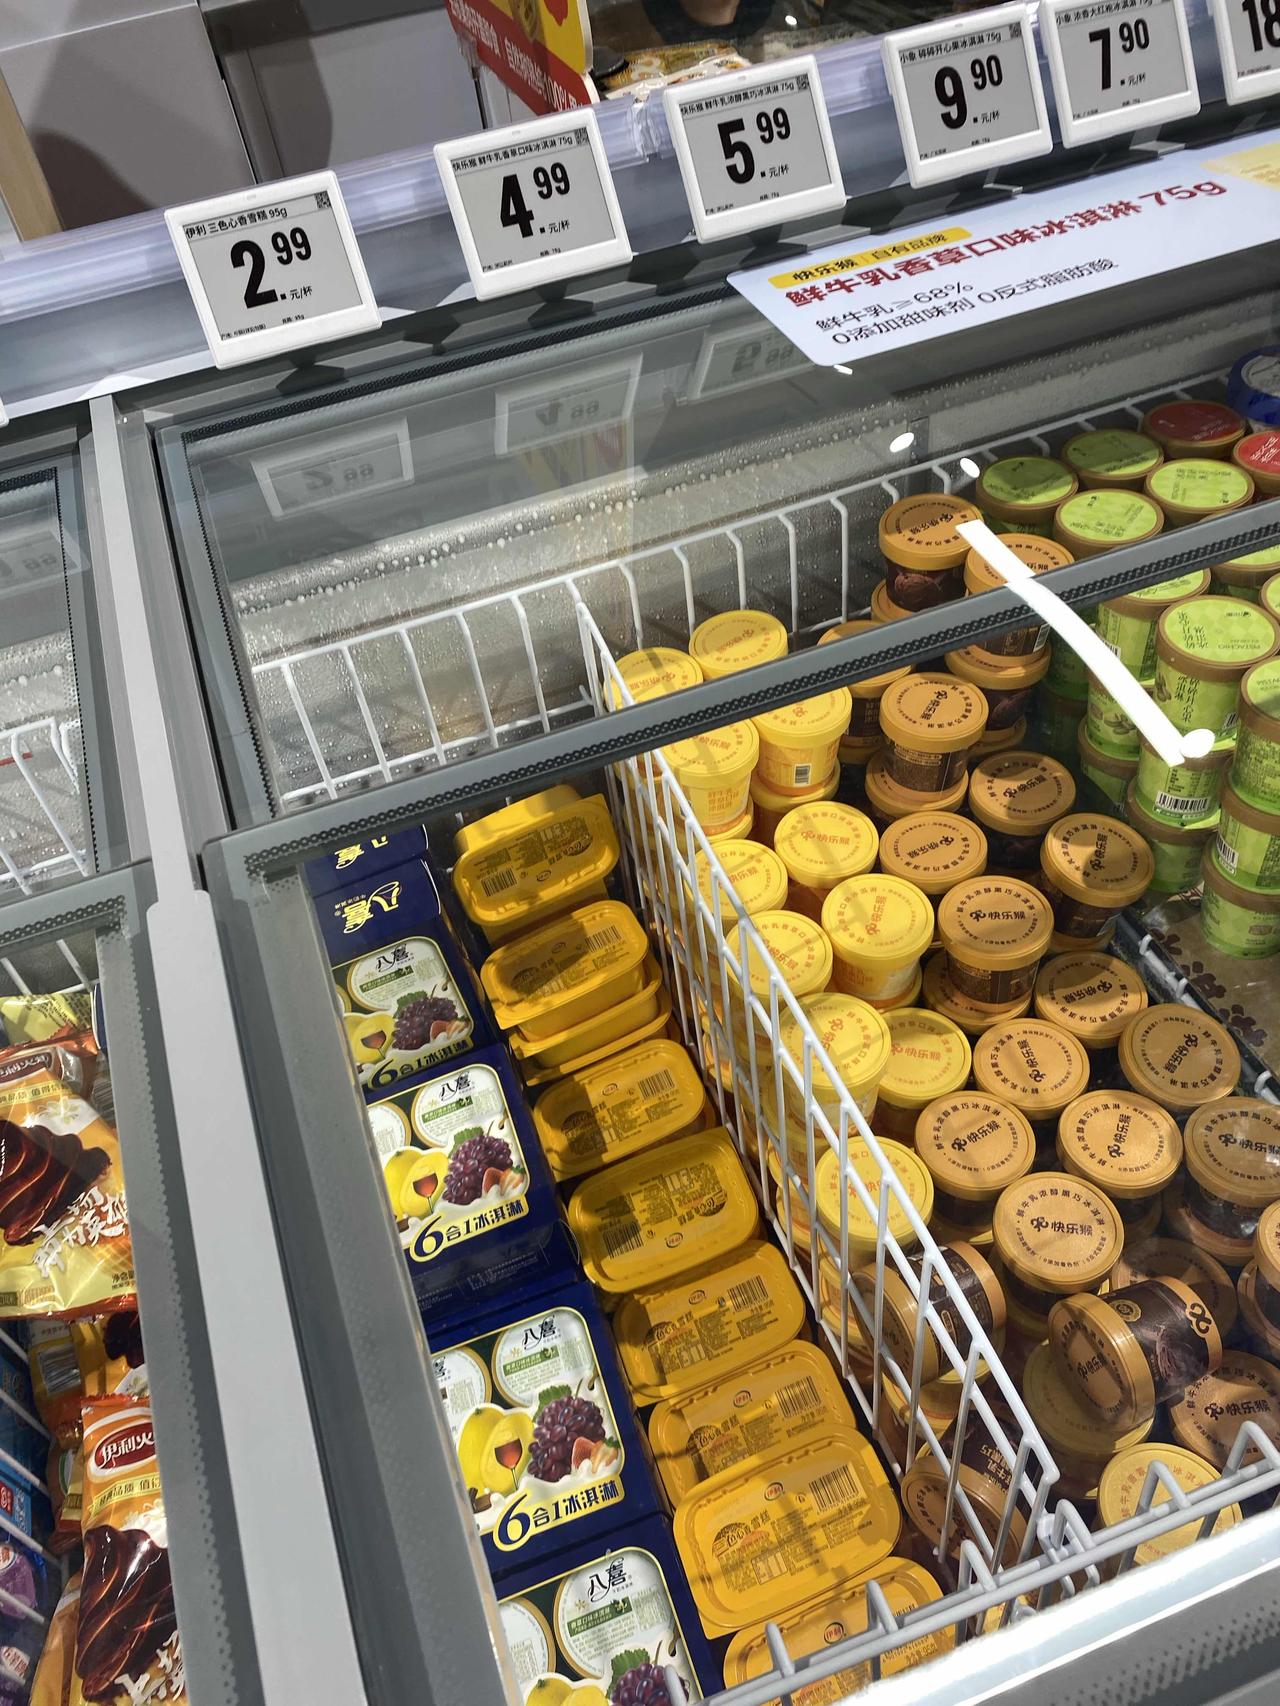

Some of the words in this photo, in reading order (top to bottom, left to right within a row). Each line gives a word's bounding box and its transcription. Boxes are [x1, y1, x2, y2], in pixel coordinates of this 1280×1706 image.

[185, 226, 206, 239] 伊利
[269, 206, 288, 218] 95g
[785, 200, 1142, 308] 鲜牛乳香草口味冰淇淋
[1139, 181, 1228, 206] 75g
[792, 259, 858, 281] 快乐猴
[872, 234, 948, 260] 自有品牌
[832, 298, 976, 346] 0添加甜味剂
[976, 258, 1119, 304] 0反式脂肪酸
[920, 699, 941, 721] 快乐猴
[1017, 775, 1047, 792] 快乐猴
[816, 834, 850, 846] 快乐猴
[907, 841, 939, 860] 快乐猴
[871, 895, 887, 926] 快乐猴
[988, 911, 1027, 922] 快乐猴
[1063, 986, 1097, 1005] 快乐猴
[905, 1048, 941, 1062] 快乐猴
[1017, 1038, 1040, 1069] 快乐猴
[1163, 1041, 1190, 1075] 快乐猴
[966, 1120, 1002, 1144] 快乐猴
[1112, 1113, 1132, 1144] 快乐猴
[1015, 1187, 1107, 1227] 鲜牛乳浓醇黑巧冰淇淋
[412, 1199, 525, 1256] 6合1冰淇淋
[1050, 1221, 1094, 1237] 快乐猴
[522, 1315, 557, 1351] 八喜
[1226, 1400, 1272, 1417] 快乐猴
[99, 1432, 154, 1469] 伊利火
[496, 1479, 620, 1547] 6合1冰淇淋
[588, 1556, 627, 1603] 八喜
